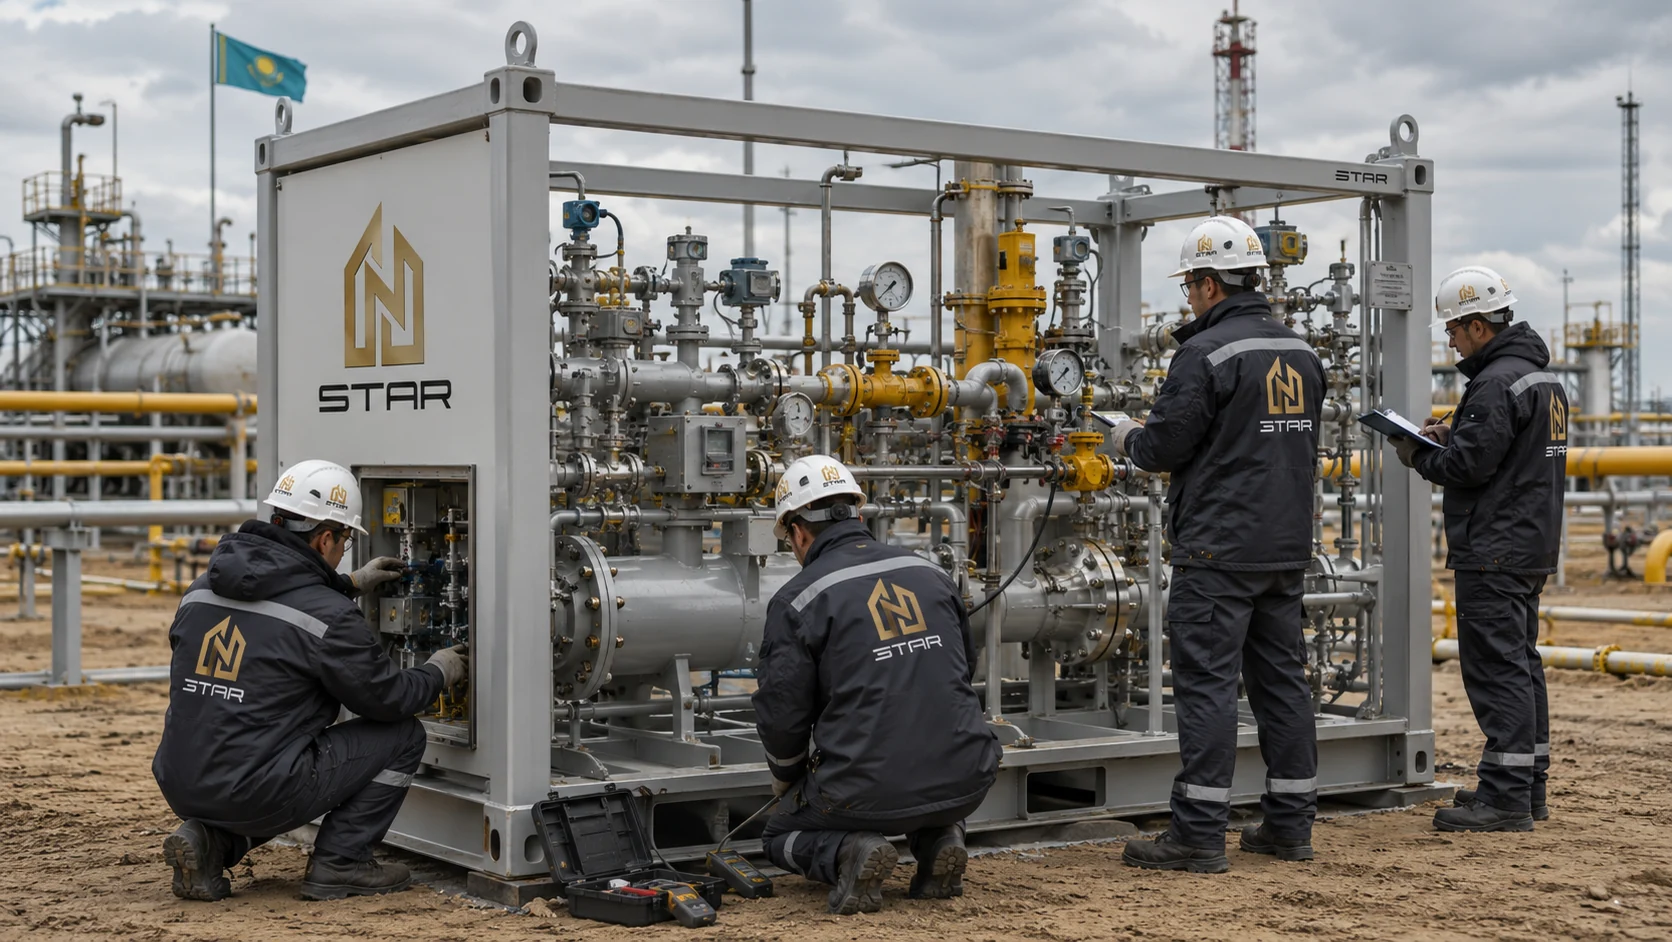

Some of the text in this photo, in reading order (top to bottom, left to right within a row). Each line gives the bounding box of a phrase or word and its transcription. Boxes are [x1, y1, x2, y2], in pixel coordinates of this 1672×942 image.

[1335, 170, 1388, 185] STAR
[319, 379, 452, 413] STAR
[1260, 420, 1312, 433] STAR
[872, 635, 943, 662] STAR
[183, 678, 245, 703] STAR
